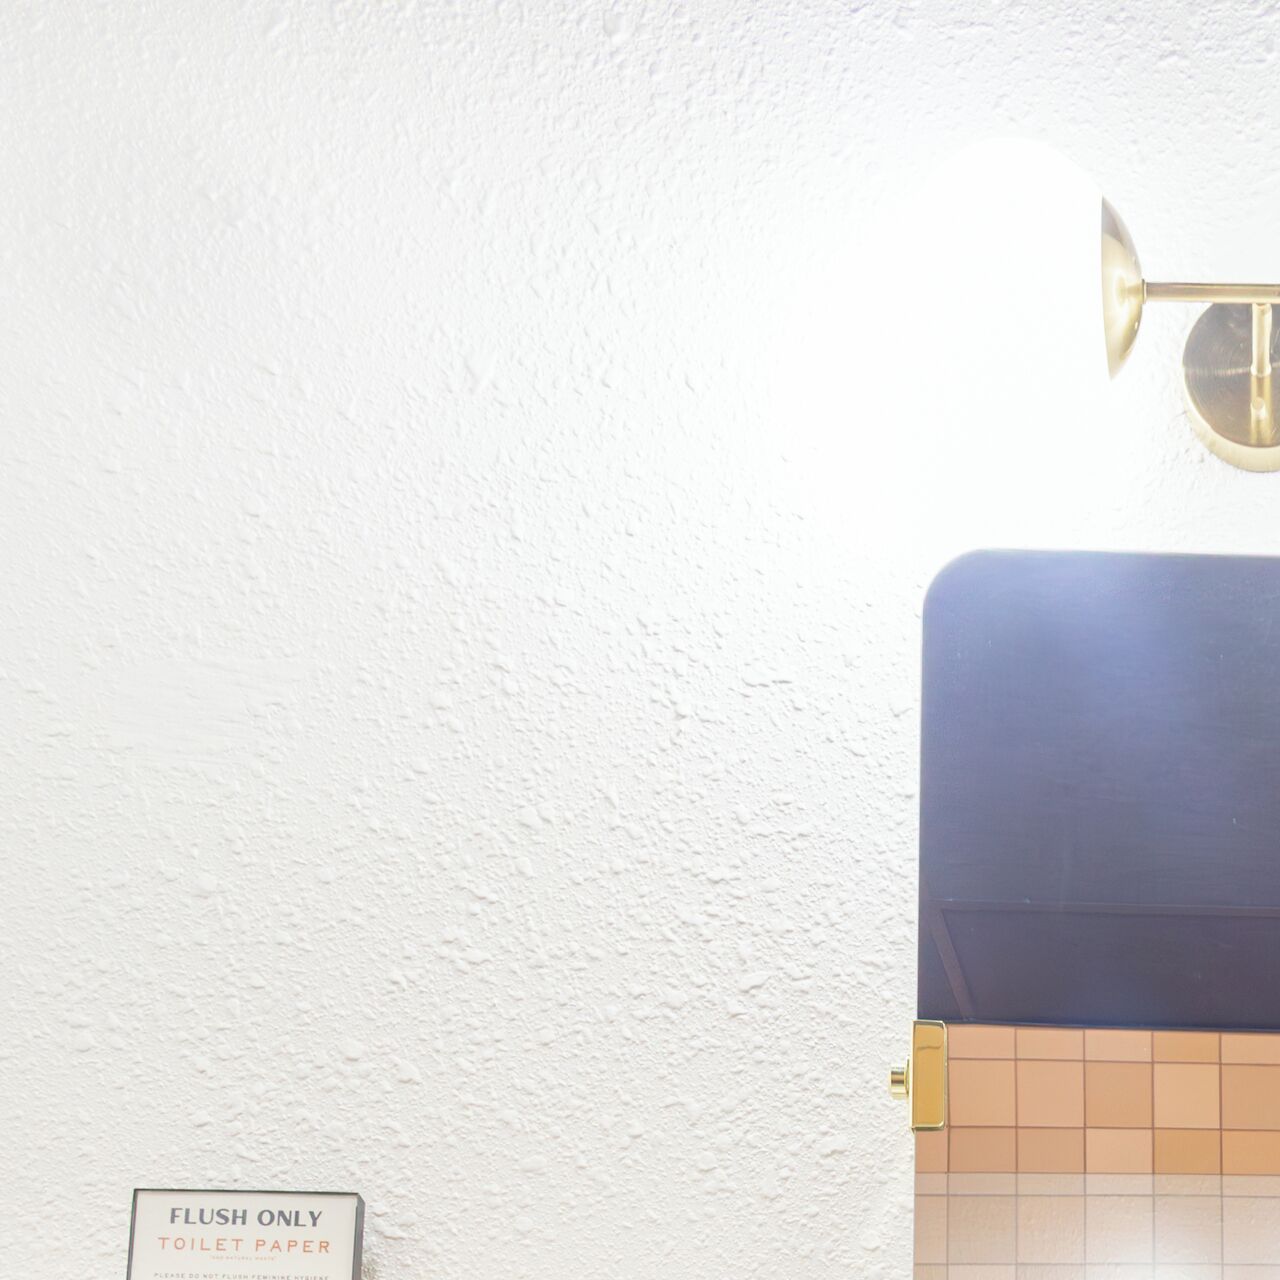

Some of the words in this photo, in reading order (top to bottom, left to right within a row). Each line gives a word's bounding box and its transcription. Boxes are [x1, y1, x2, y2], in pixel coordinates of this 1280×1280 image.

[170, 1207, 248, 1226] FLUSH
[256, 1209, 323, 1227] ONLY
[158, 1237, 243, 1252] TOILET
[255, 1239, 330, 1254] PAPER
